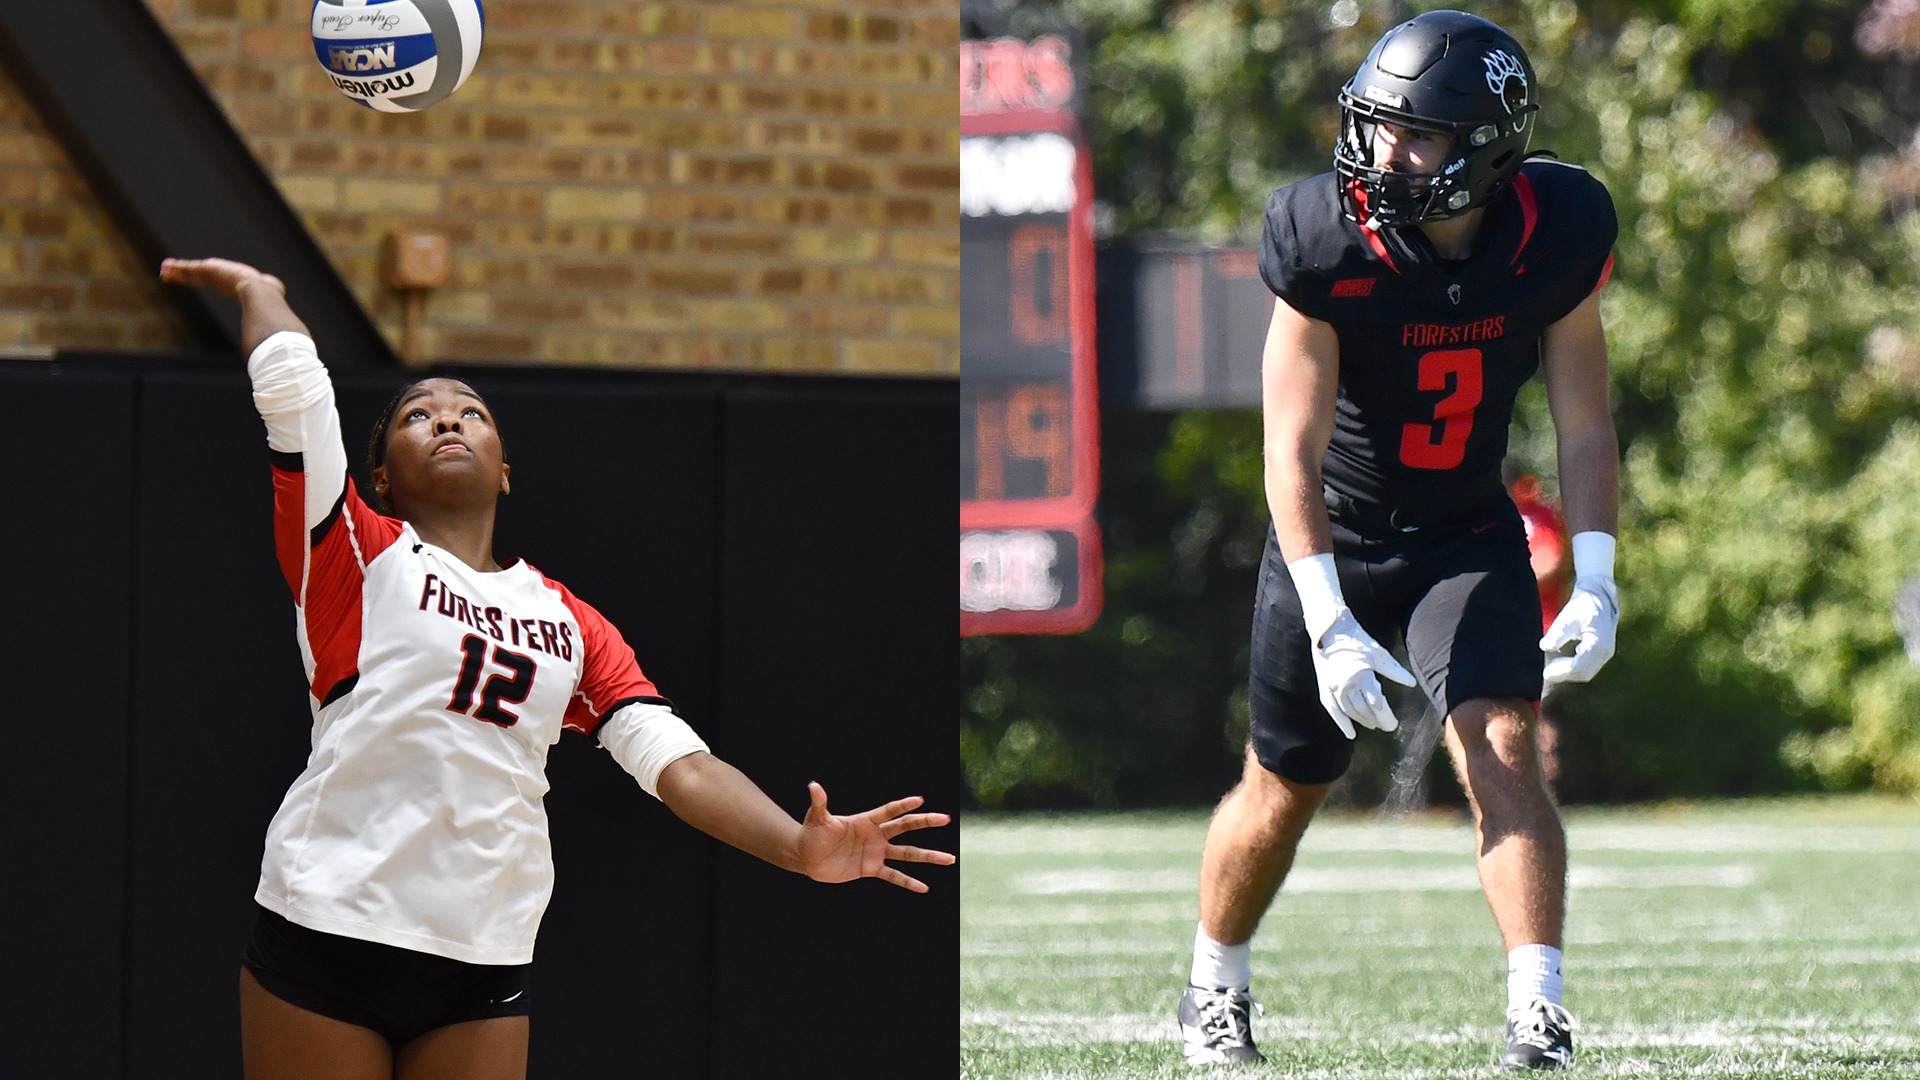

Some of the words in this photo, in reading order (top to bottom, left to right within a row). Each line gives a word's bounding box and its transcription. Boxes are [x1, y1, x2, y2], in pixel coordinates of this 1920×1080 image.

[358, 10, 400, 31] Super
[328, 45, 396, 71] NCAA
[330, 71, 414, 97] molten
[1402, 315, 1505, 347] FORESTERS
[1400, 348, 1483, 470] 3
[419, 573, 573, 663] FORESTERS
[445, 633, 537, 728] 12
